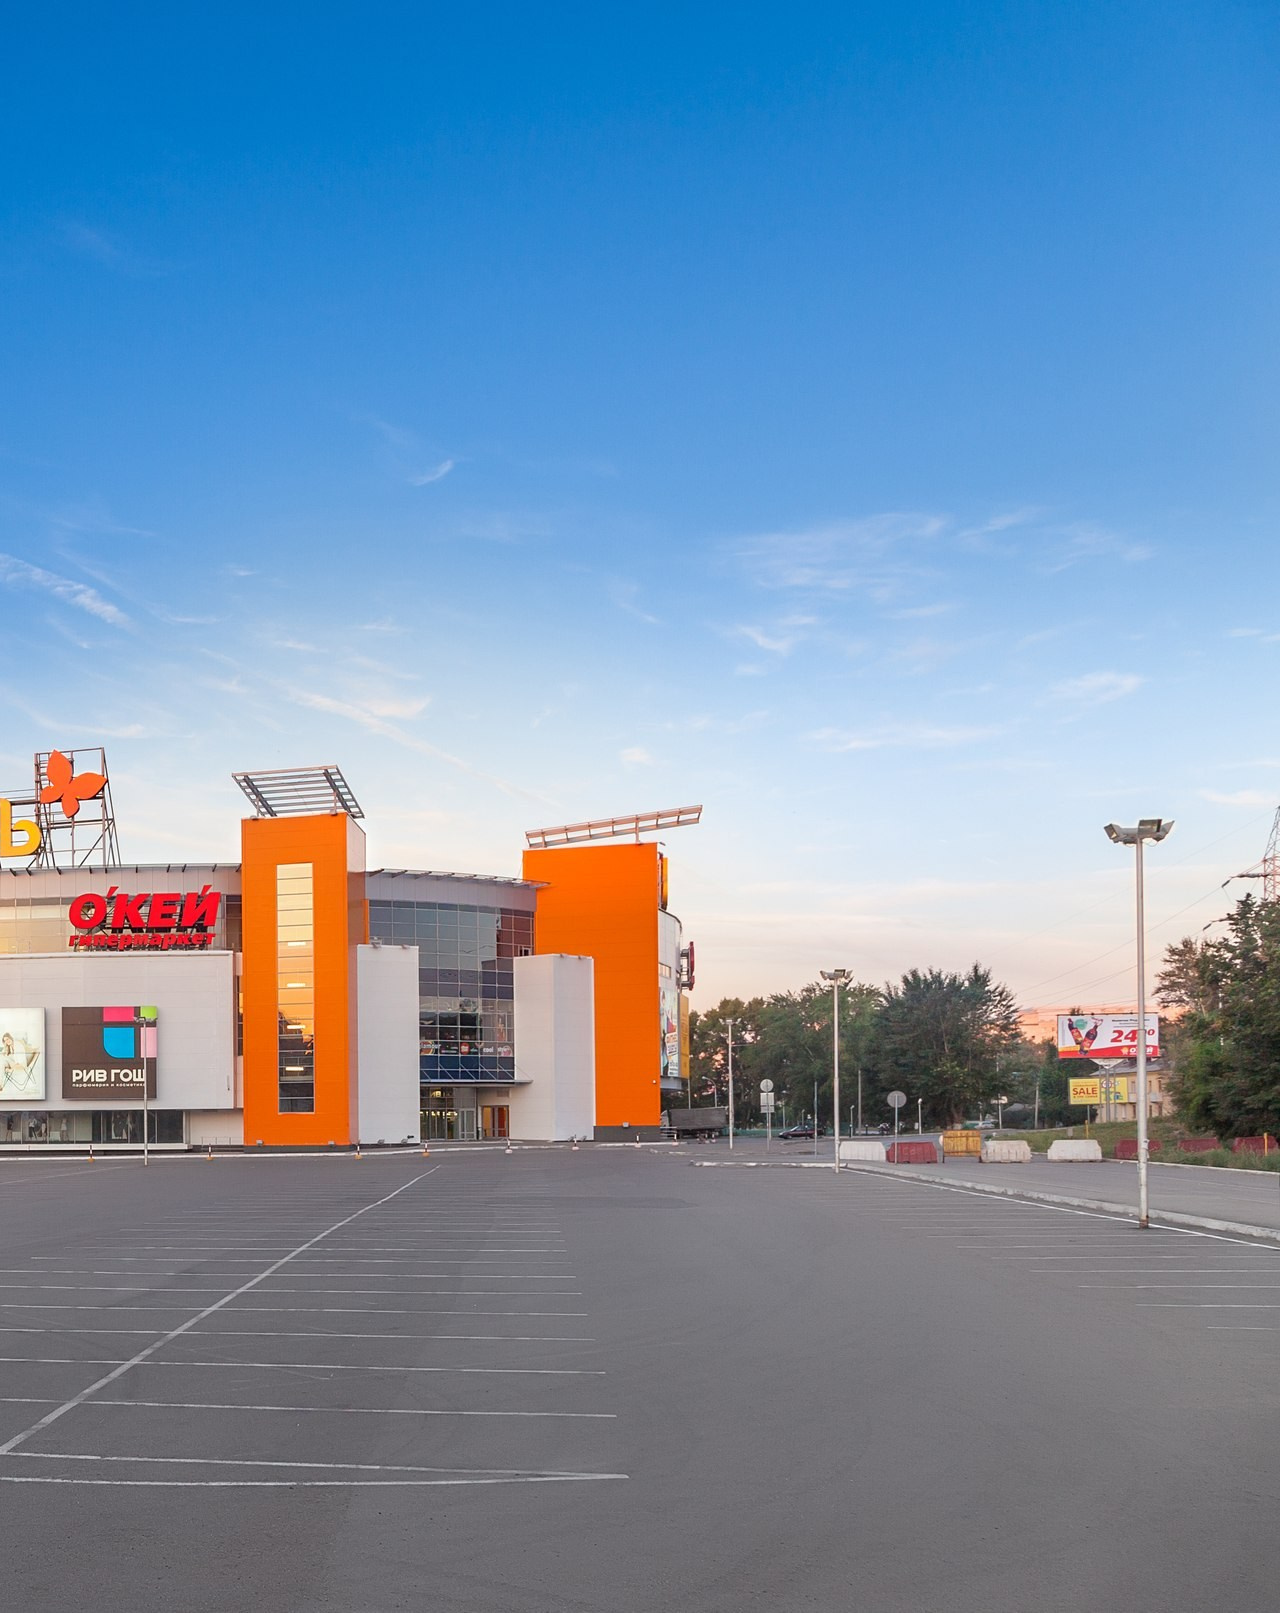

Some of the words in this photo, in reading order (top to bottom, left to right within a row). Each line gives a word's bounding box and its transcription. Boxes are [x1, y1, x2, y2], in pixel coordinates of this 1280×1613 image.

[68, 933, 216, 949] гипермаркет
[72, 1069, 107, 1082] РИВ
[110, 1069, 145, 1082] ГОШ
[1072, 1087, 1098, 1096] SALE
